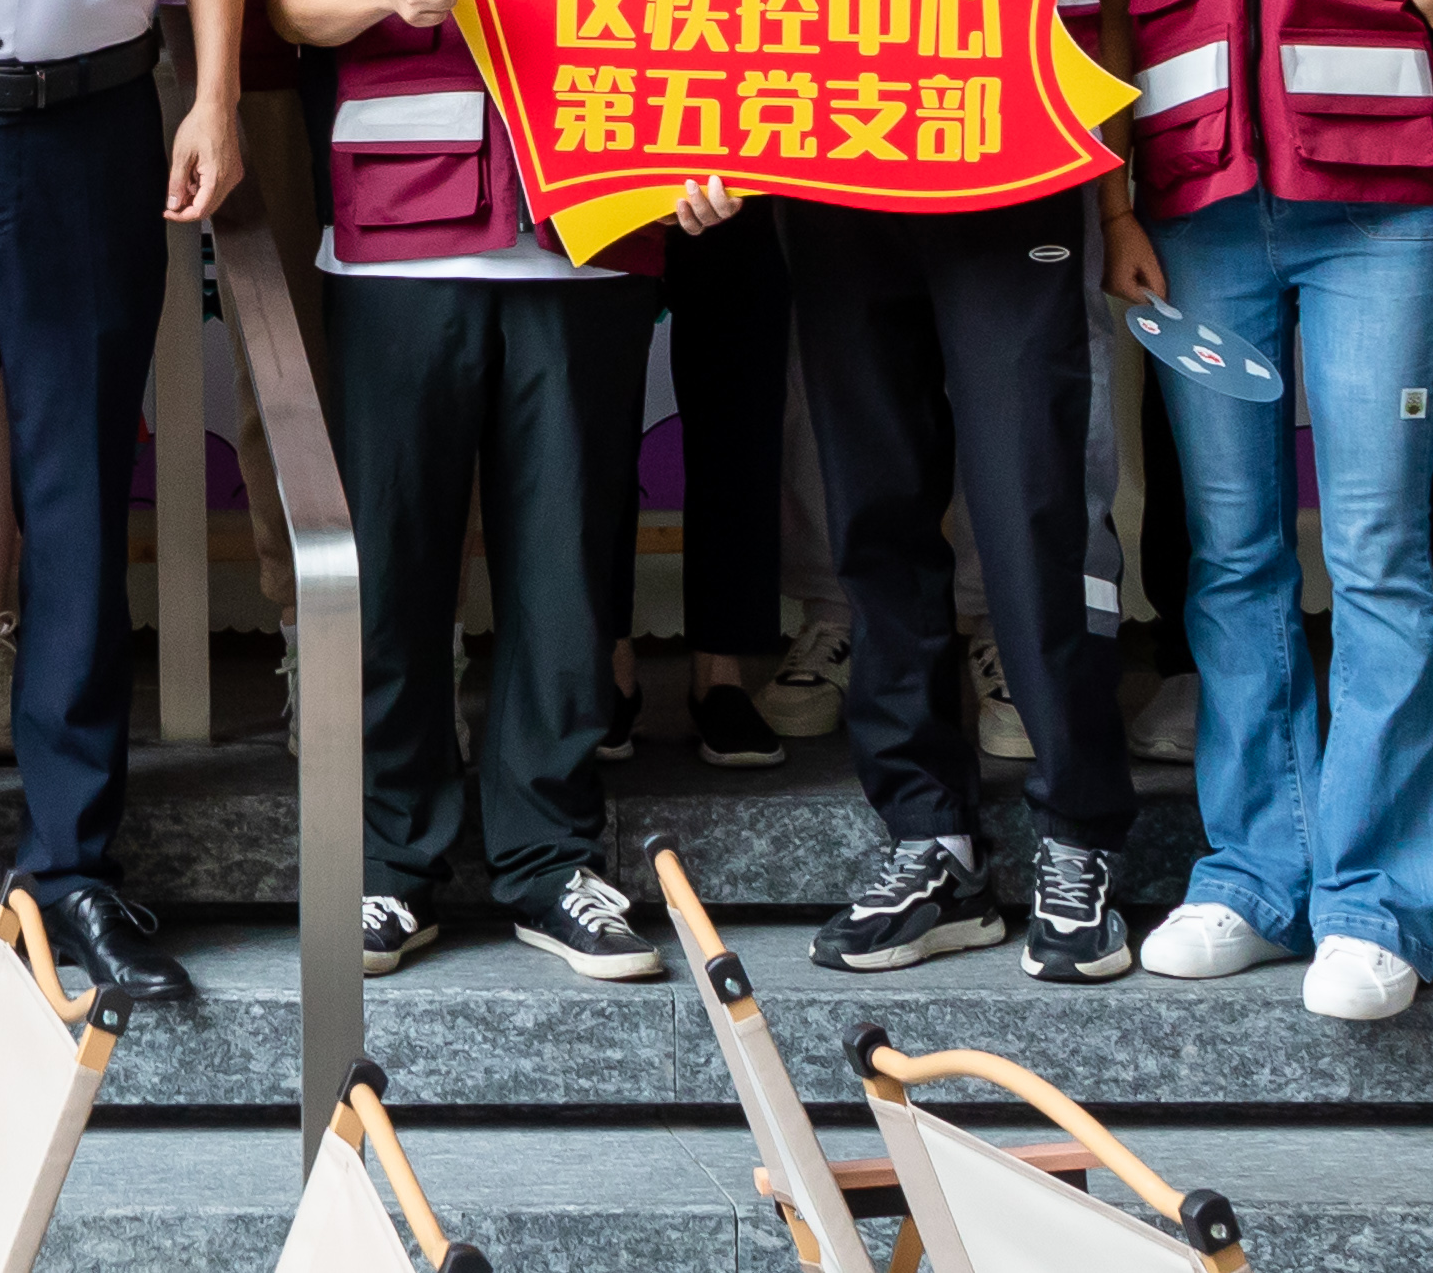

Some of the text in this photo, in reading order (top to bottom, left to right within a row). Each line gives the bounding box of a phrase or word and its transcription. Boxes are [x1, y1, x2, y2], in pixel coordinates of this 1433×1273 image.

[553, 65, 1003, 163] 第五党支部
